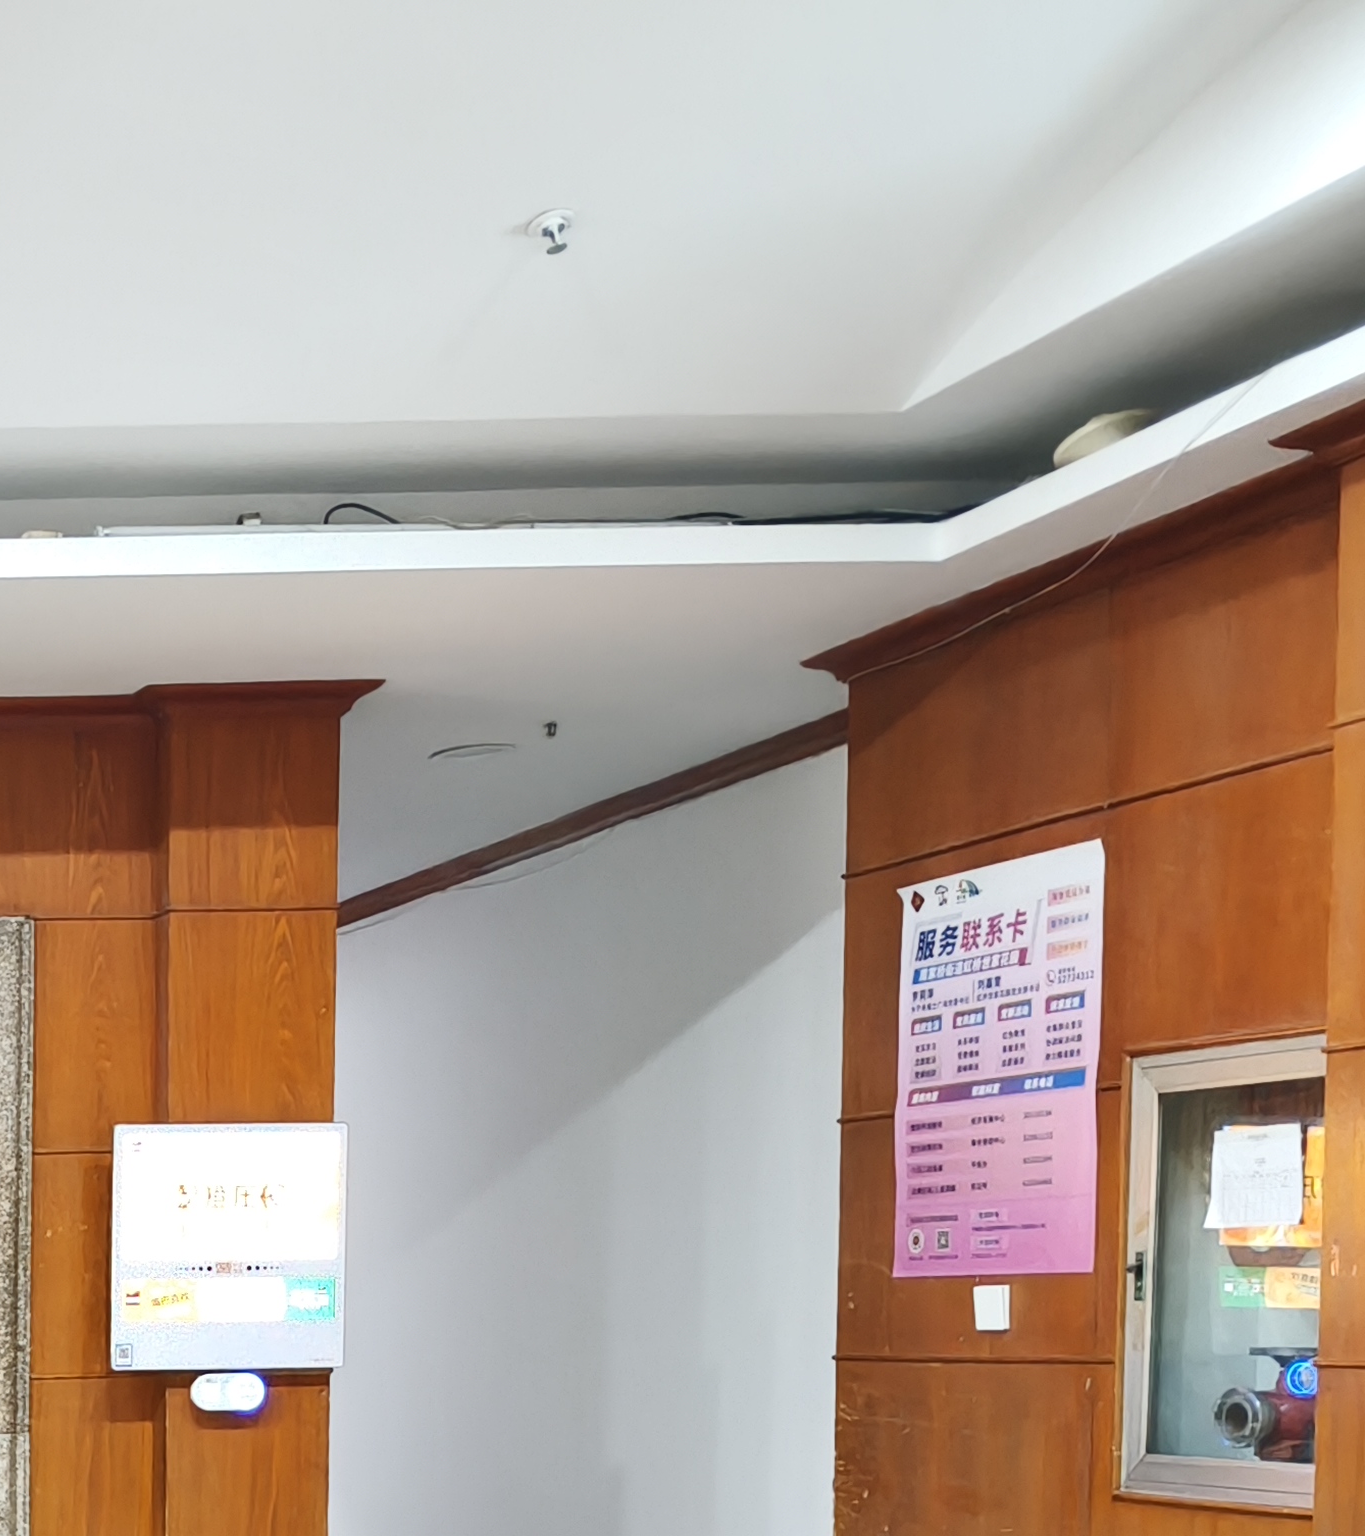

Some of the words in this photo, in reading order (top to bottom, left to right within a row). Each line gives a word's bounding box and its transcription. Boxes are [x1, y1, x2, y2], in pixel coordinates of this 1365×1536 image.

[914, 908, 1028, 963] 服务联系卡
